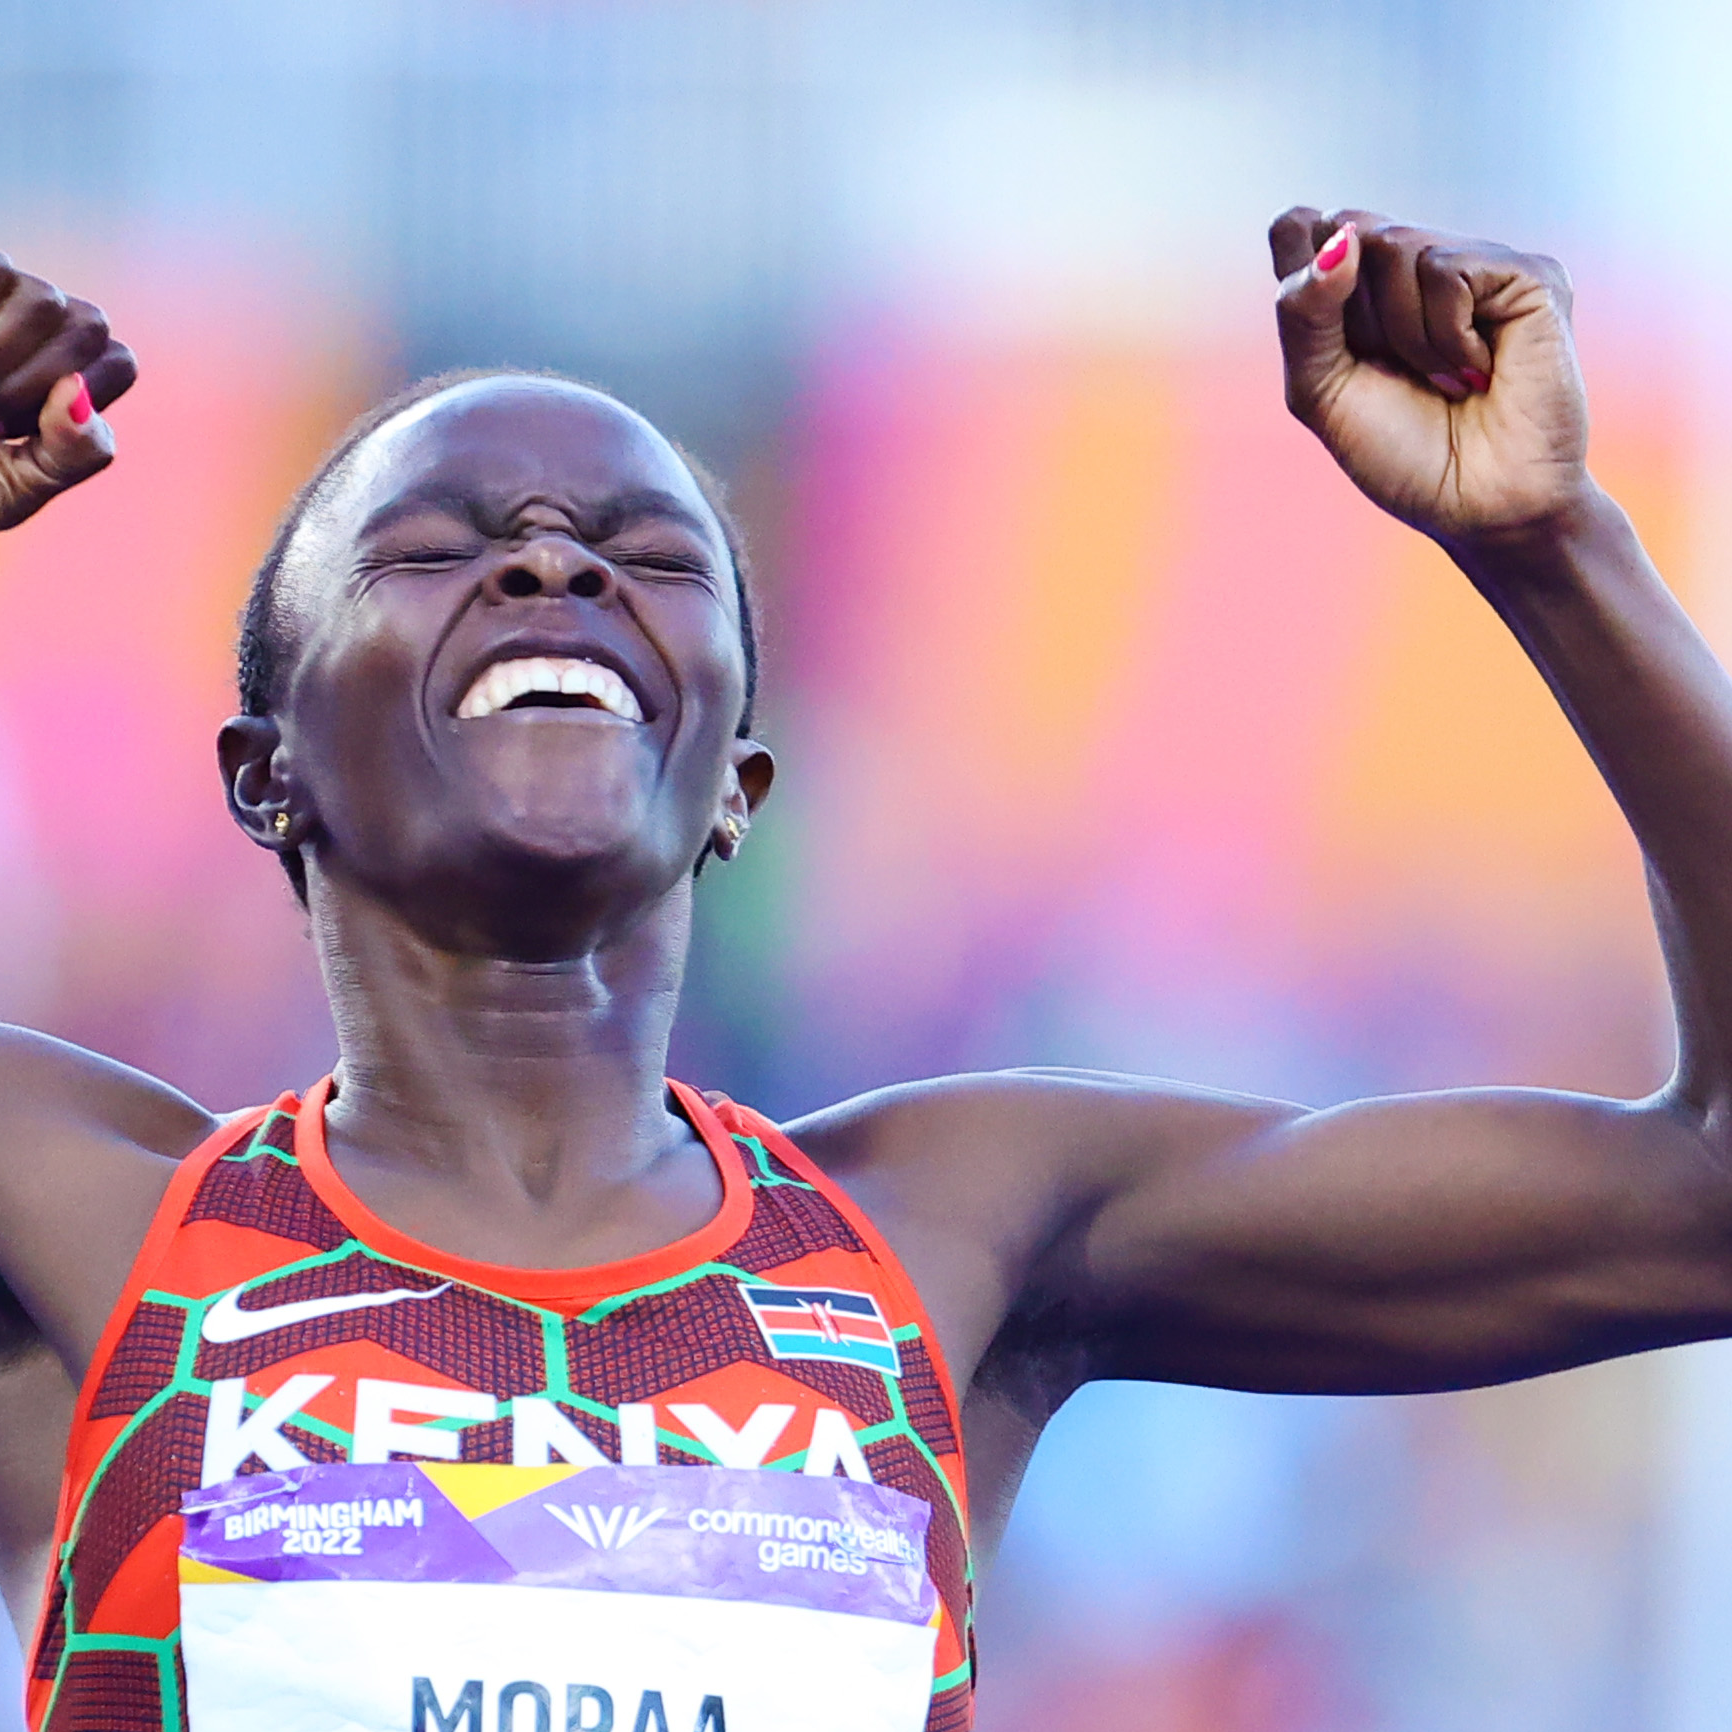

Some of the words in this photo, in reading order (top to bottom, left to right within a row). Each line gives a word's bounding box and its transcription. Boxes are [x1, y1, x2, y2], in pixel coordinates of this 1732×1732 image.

[224, 1498, 423, 1540] BIRMINGHAM
[282, 1528, 363, 1554] 2022
[758, 1540, 868, 1575] games
